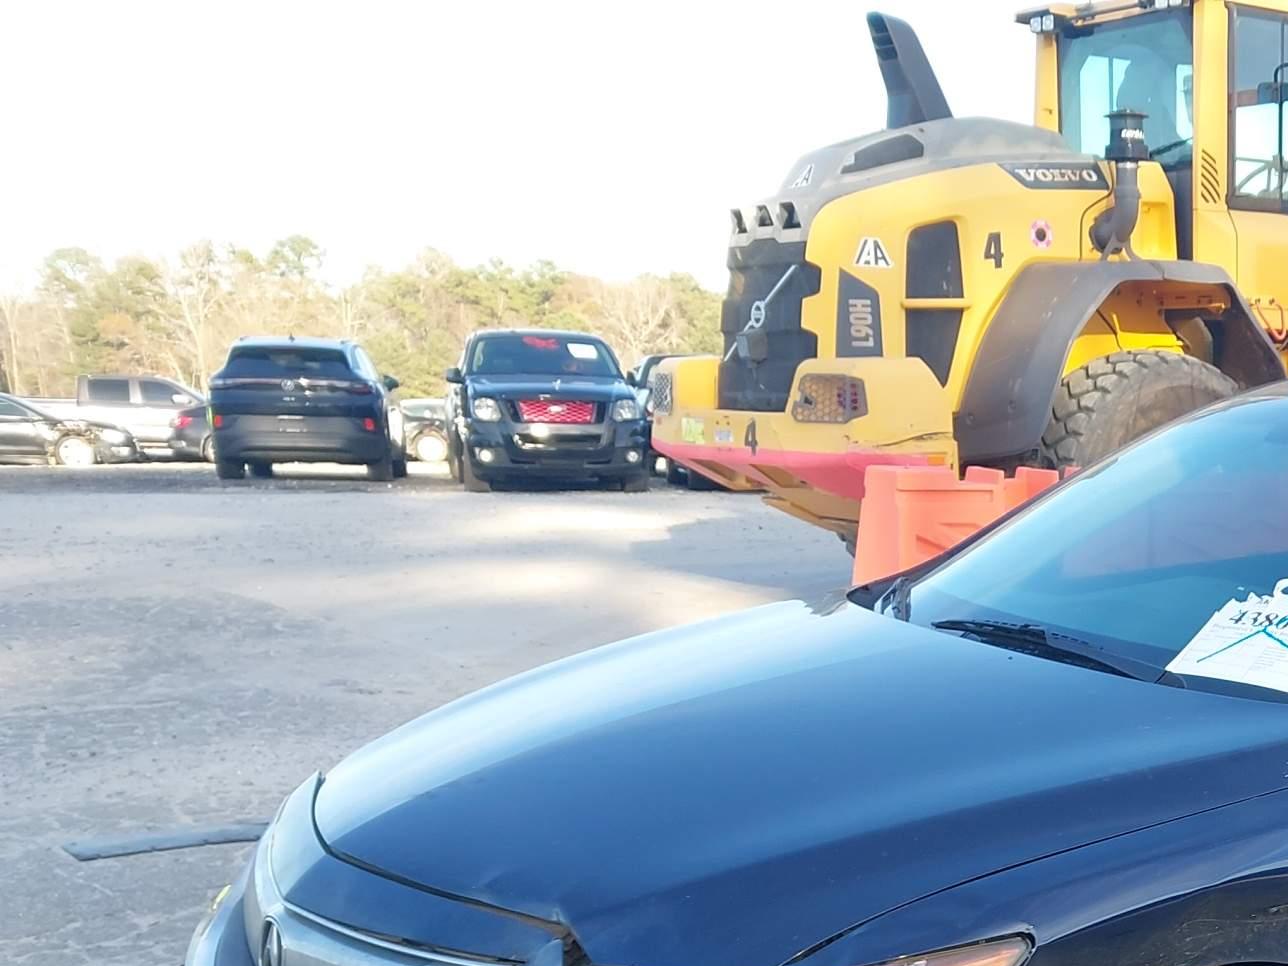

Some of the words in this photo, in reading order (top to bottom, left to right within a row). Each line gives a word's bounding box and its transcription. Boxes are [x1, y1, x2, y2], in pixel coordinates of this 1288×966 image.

[1014, 168, 1098, 182] VOLVO
[983, 231, 1004, 269] 4
[847, 299, 874, 348] L90H
[744, 417, 759, 456] 4
